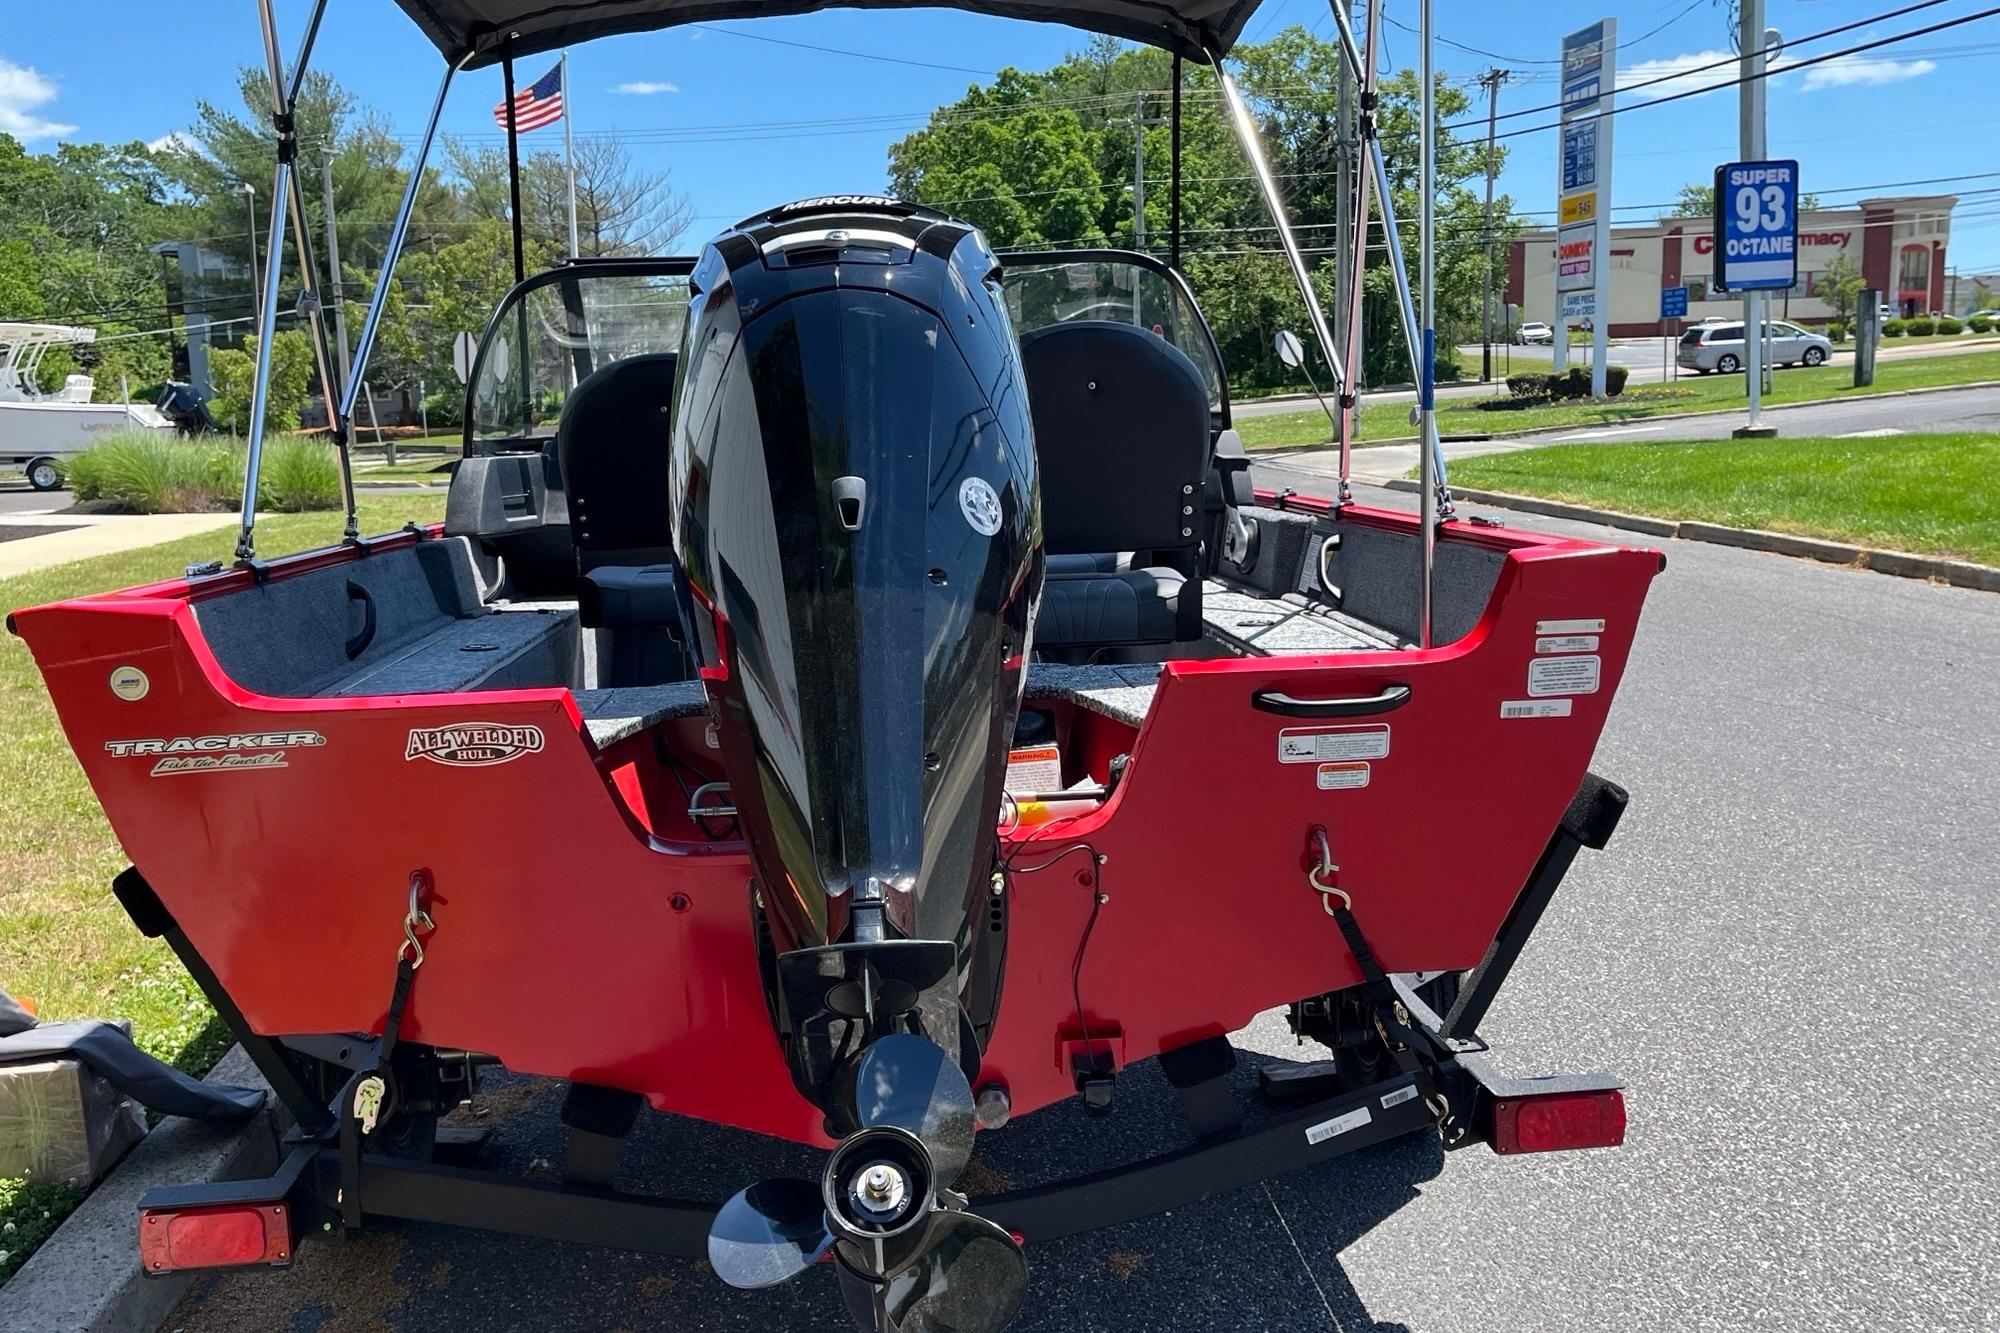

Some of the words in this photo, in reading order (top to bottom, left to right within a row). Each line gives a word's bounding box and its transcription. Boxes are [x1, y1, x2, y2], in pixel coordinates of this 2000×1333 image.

[1731, 168, 1790, 186] SUPER
[782, 196, 902, 212] MERCURY
[1736, 185, 1785, 232] 93
[1726, 236, 1793, 256] OCTANE
[1797, 232, 1851, 248] macy
[1580, 294, 1596, 304] PRICE
[107, 732, 317, 756] TRACKER
[408, 731, 450, 755] ALL
[451, 728, 541, 749] WELDED
[456, 748, 496, 760] HULL
[157, 757, 193, 770] Fish
[193, 757, 217, 768] the
